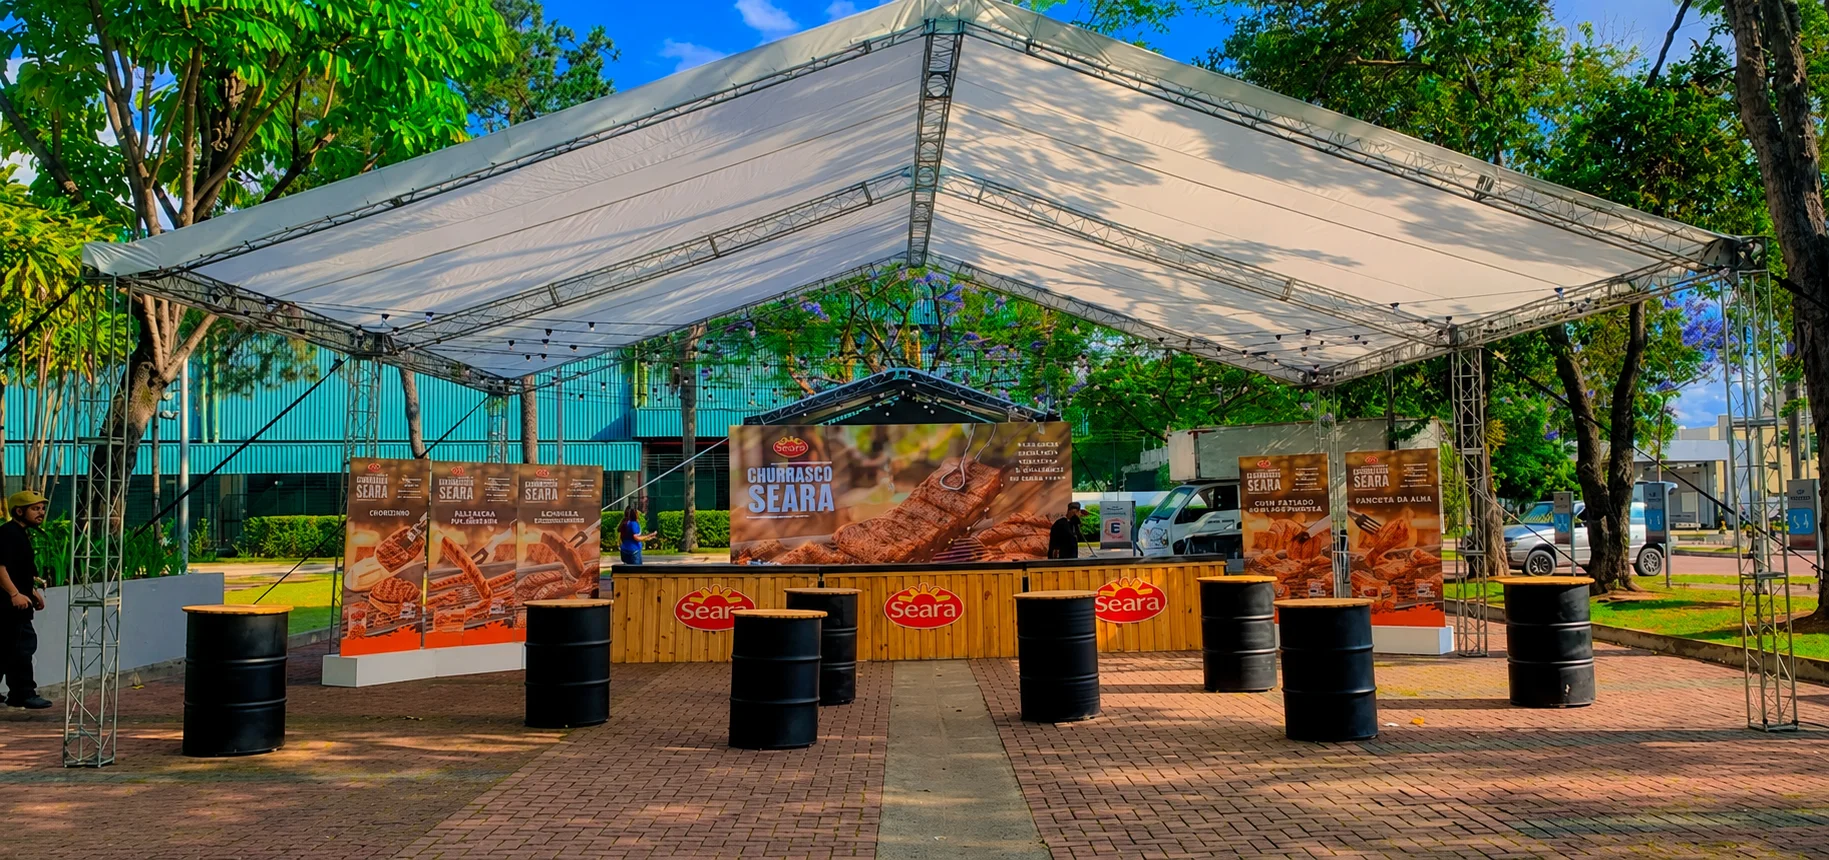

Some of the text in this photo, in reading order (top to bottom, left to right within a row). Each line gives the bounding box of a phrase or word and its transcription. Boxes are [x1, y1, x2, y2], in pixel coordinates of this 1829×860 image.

[747, 466, 833, 483] CHURRASCO
[1354, 474, 1390, 488] SEARA
[356, 484, 388, 499] SEARA
[439, 486, 474, 500] SEARA
[1247, 478, 1282, 492] SEARA
[525, 488, 558, 500] SEARA
[748, 483, 835, 513] SEARA
[680, 602, 747, 620] Sear
[890, 601, 956, 618] Seara
[1095, 595, 1160, 613] Seara
